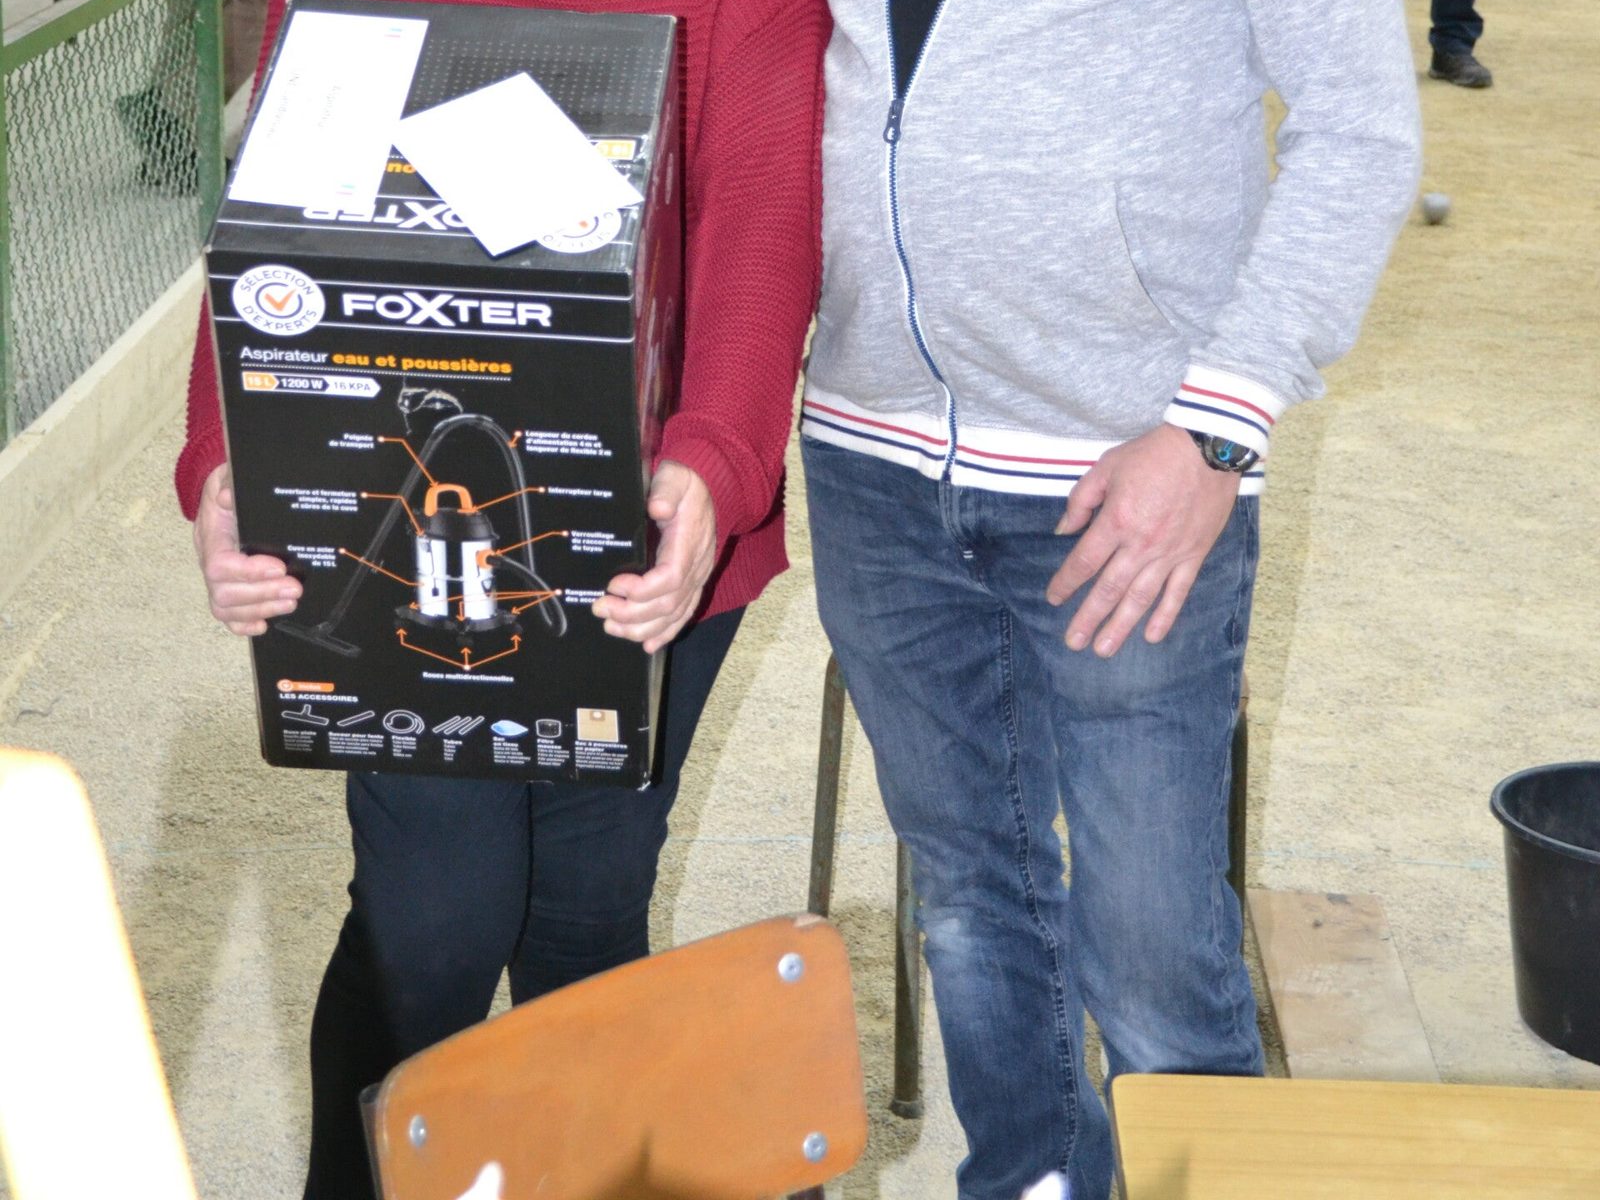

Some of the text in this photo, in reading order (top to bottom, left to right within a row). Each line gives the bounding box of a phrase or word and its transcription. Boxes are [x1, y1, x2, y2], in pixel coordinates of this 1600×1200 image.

[342, 291, 552, 327] FOXTER
[240, 346, 513, 374] Aspirateur eau et poussières
[281, 378, 324, 390] 1200 W
[340, 440, 375, 449] transport
[279, 692, 358, 703] LES ACCESSOIRES
